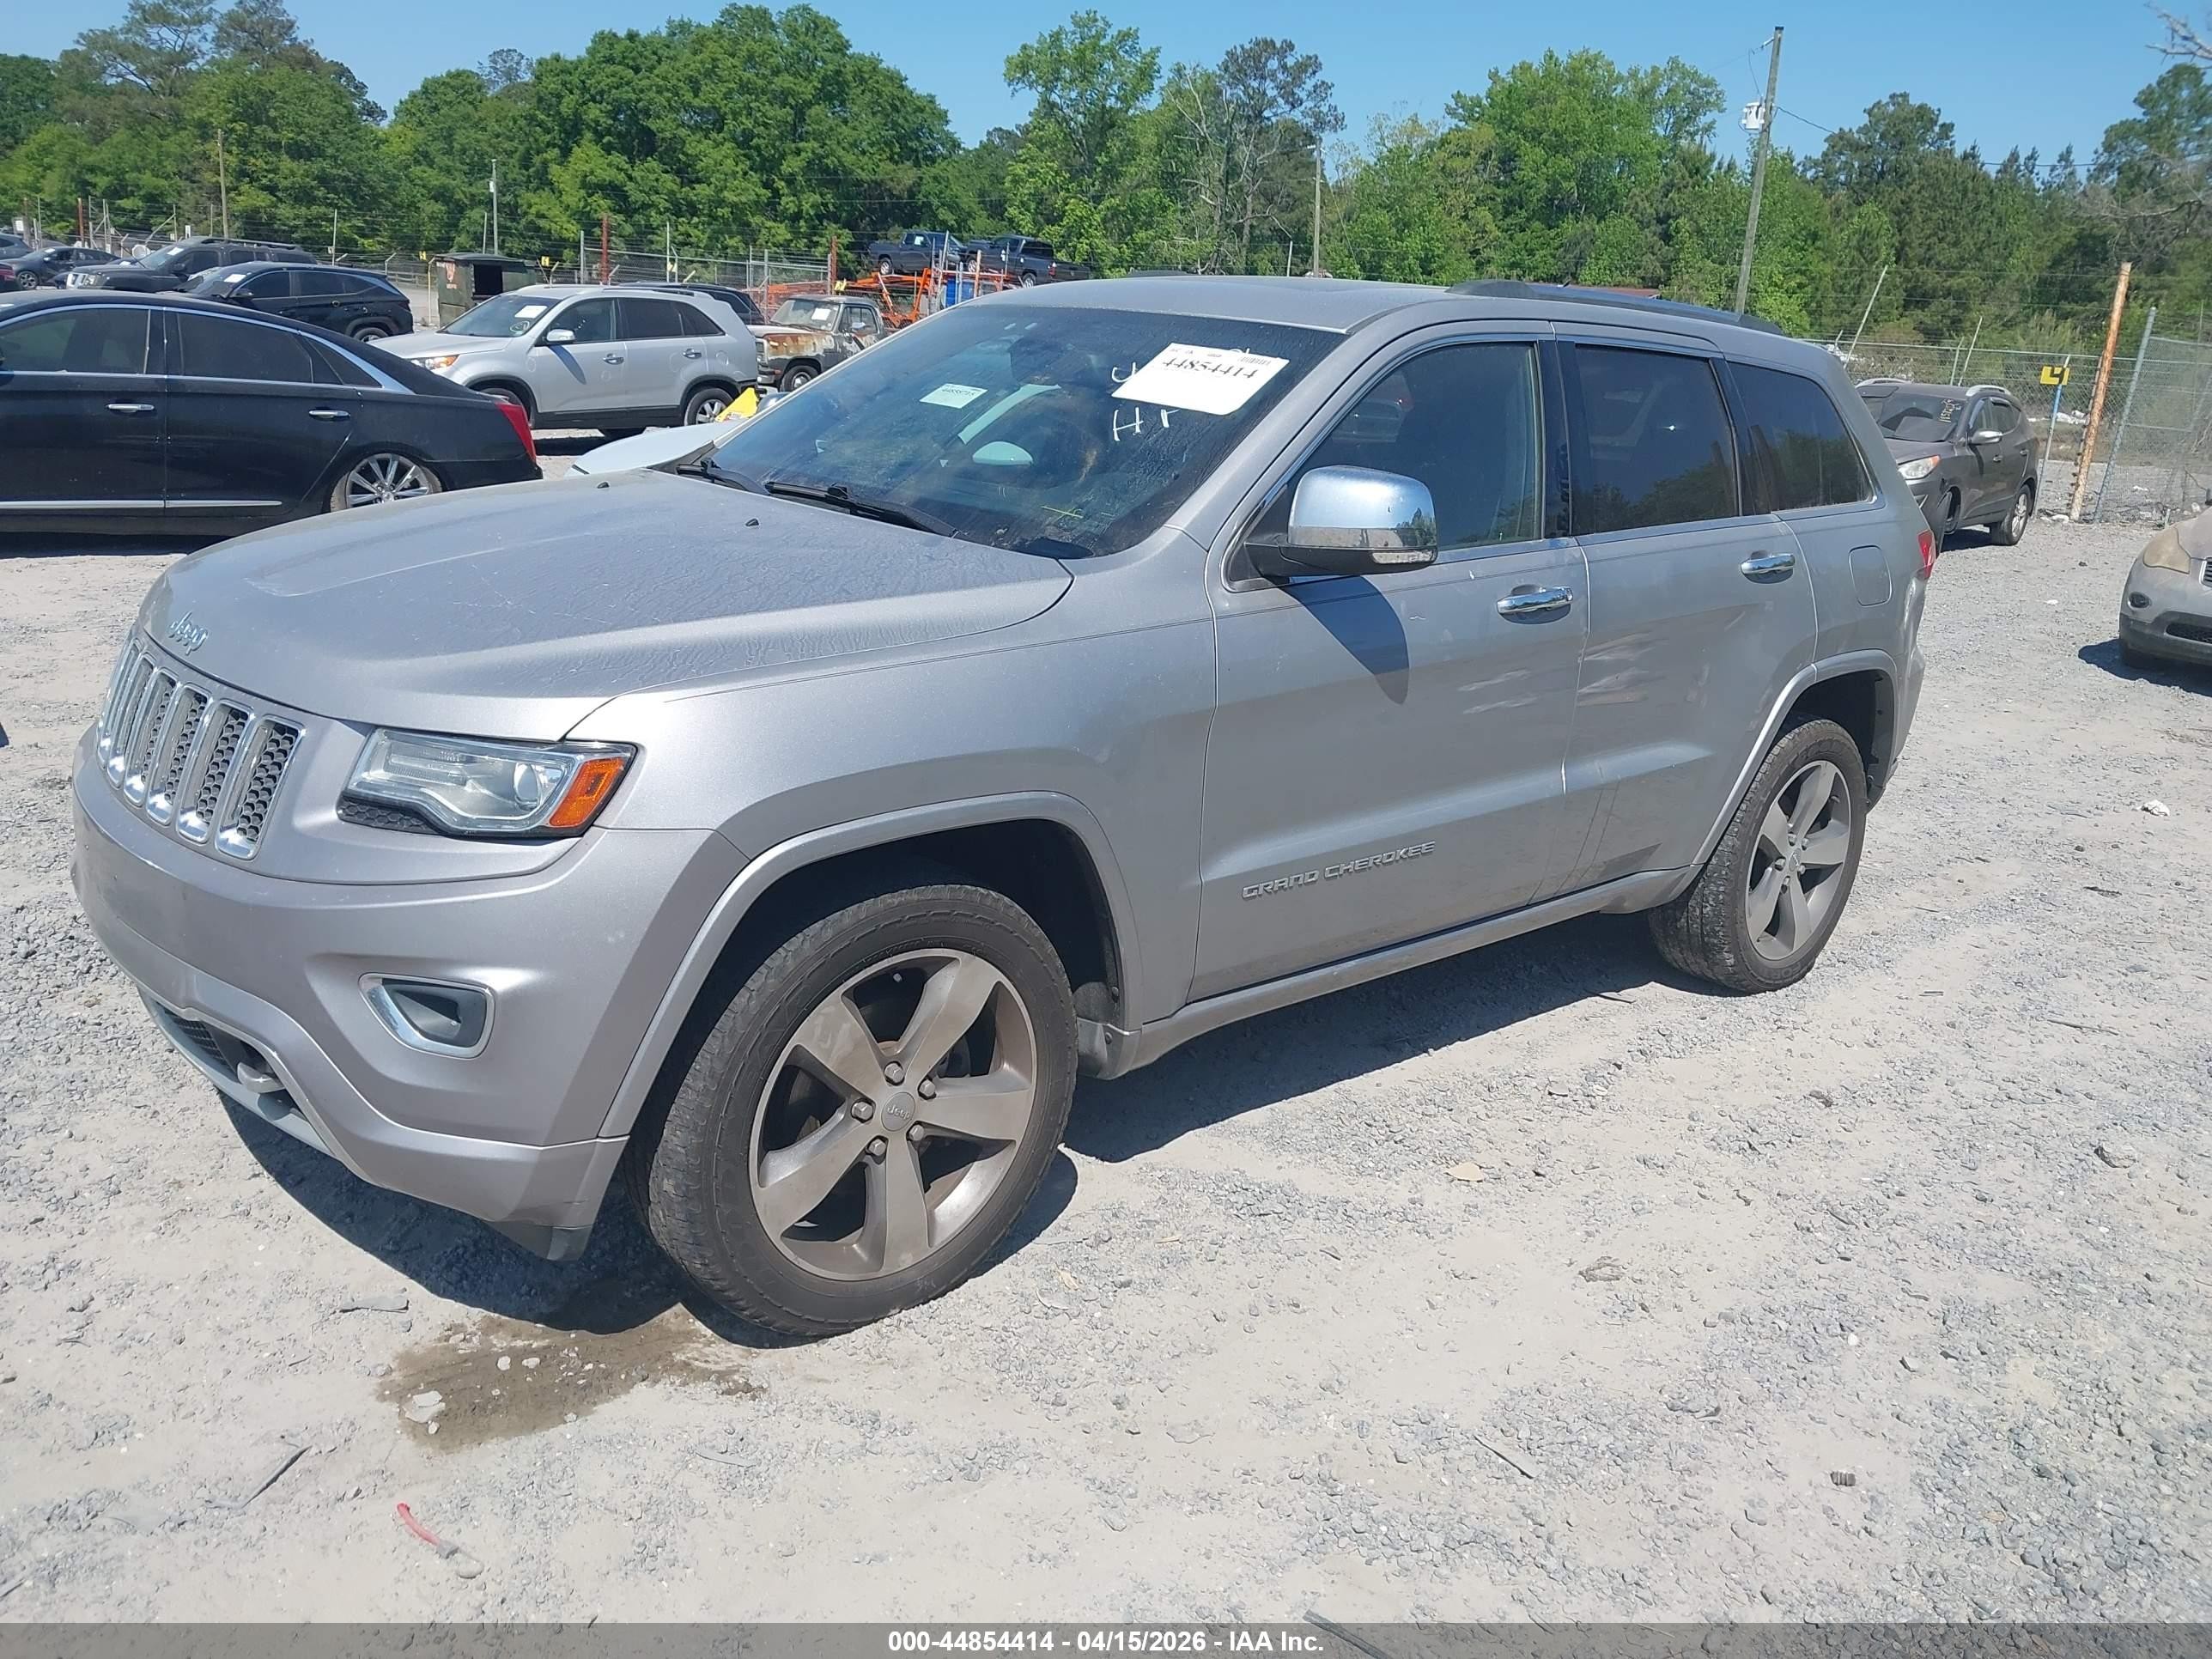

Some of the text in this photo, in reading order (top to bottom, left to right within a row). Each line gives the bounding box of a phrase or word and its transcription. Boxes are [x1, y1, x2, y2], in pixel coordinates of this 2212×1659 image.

[1163, 357, 1258, 379] 44854414
[169, 611, 208, 655] Jeep
[1242, 841, 1436, 899] GRAND CHEROKEE
[887, 1104, 912, 1120] Jeep
